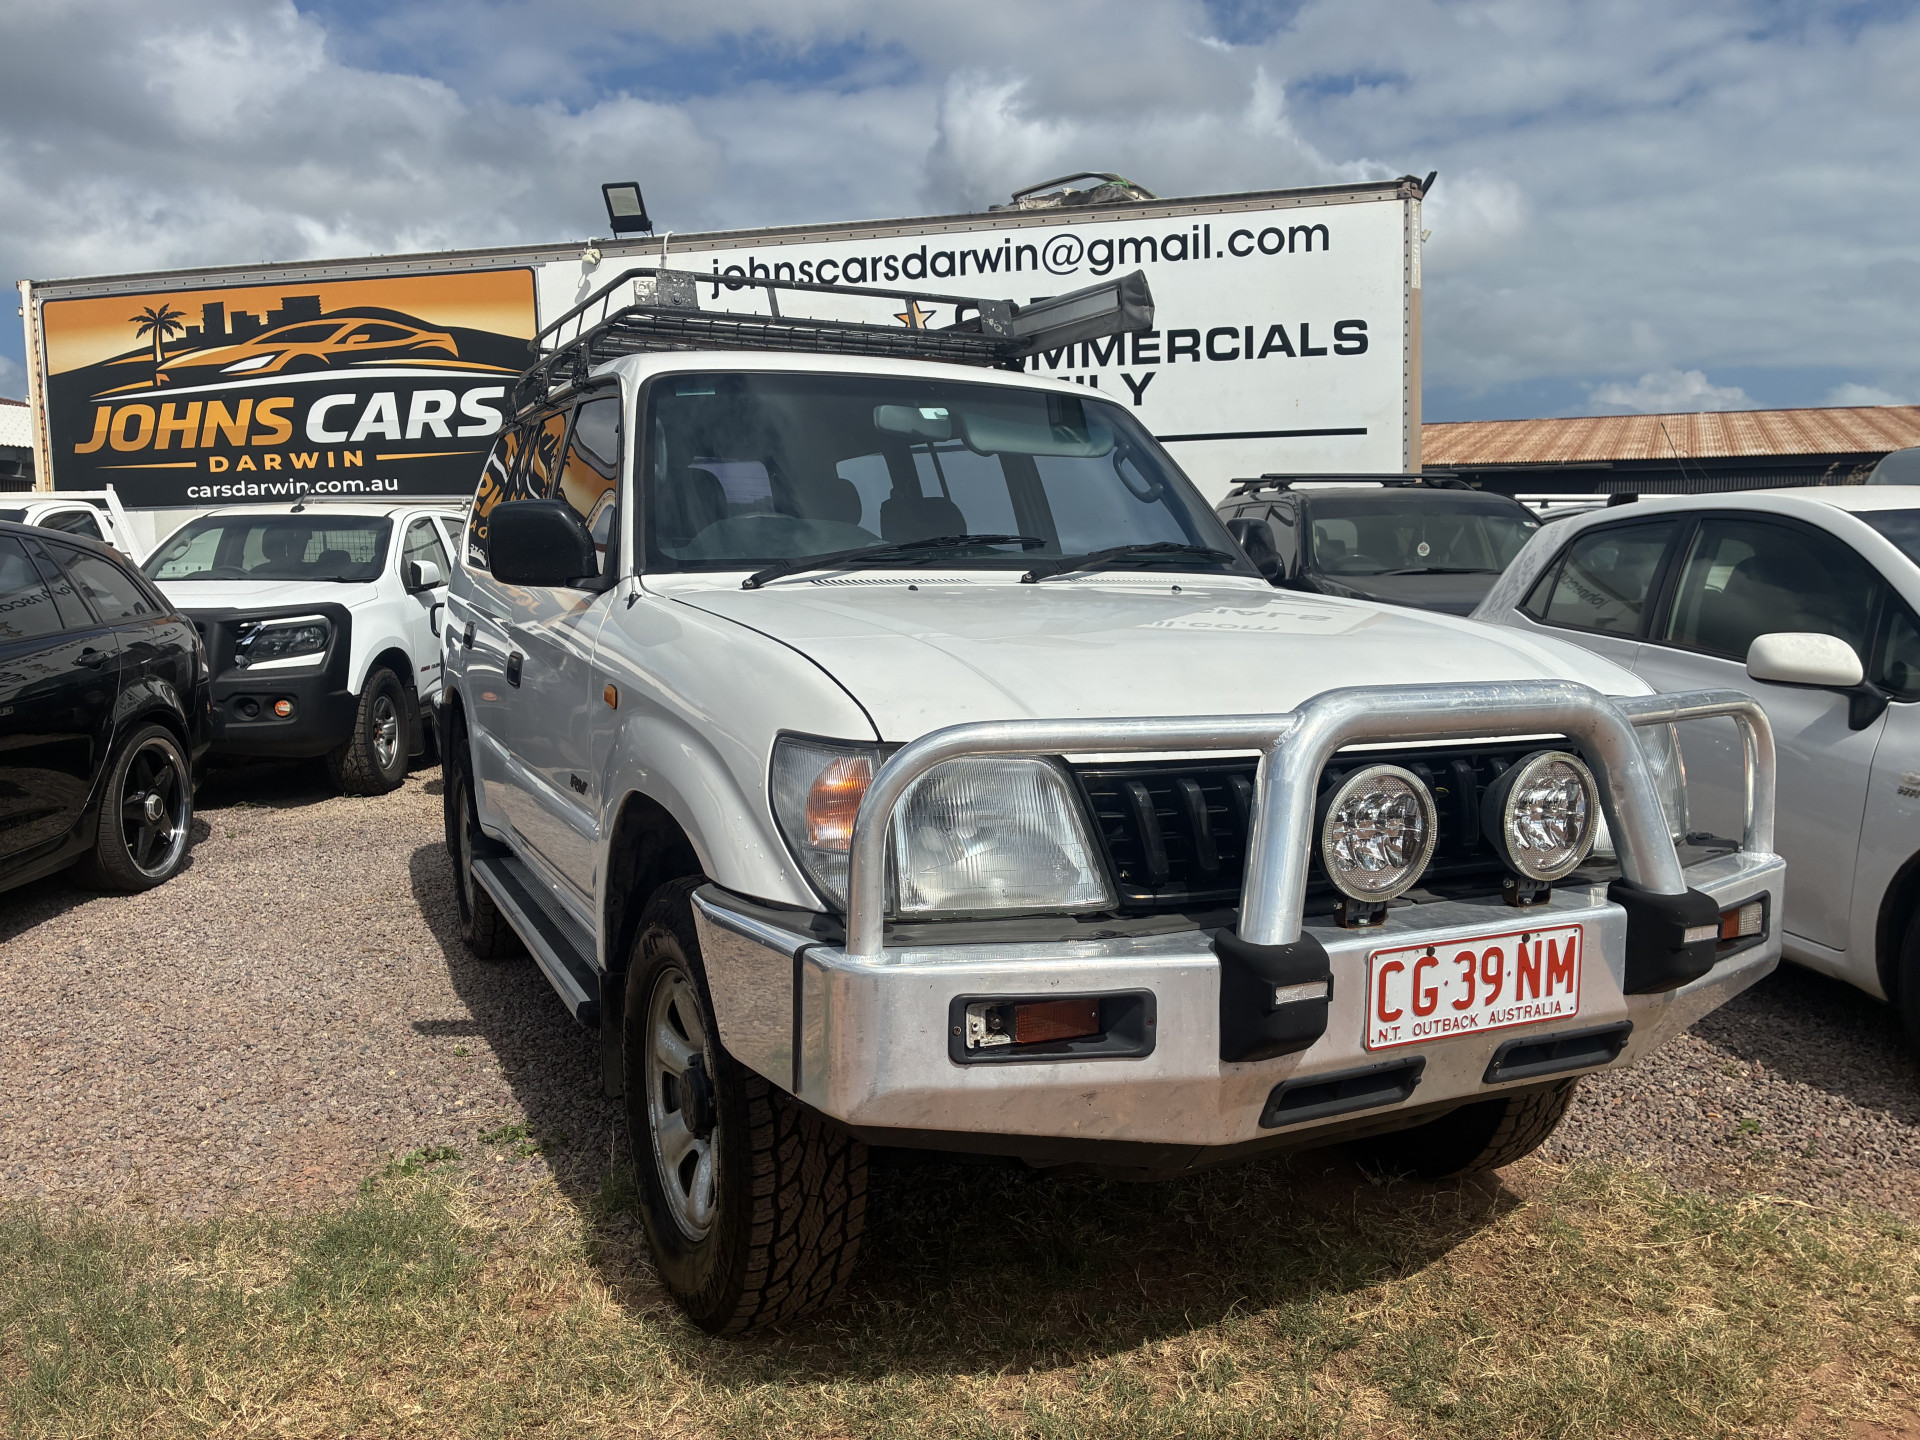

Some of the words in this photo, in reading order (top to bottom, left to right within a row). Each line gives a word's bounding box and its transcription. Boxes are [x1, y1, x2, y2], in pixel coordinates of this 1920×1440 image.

[712, 223, 1330, 299] johnscarsdarwin@gmail.com
[1024, 319, 1369, 371] MMERCIALS
[74, 396, 295, 454] JOHNS
[305, 386, 506, 444] CARS
[208, 450, 364, 473] DARWIN
[186, 477, 399, 499] carsdarwin.com.au
[1378, 1026, 1402, 1044] N.T.
[1413, 1013, 1479, 1037] OUTBACK
[1488, 1000, 1562, 1025] AUSTRALIA
